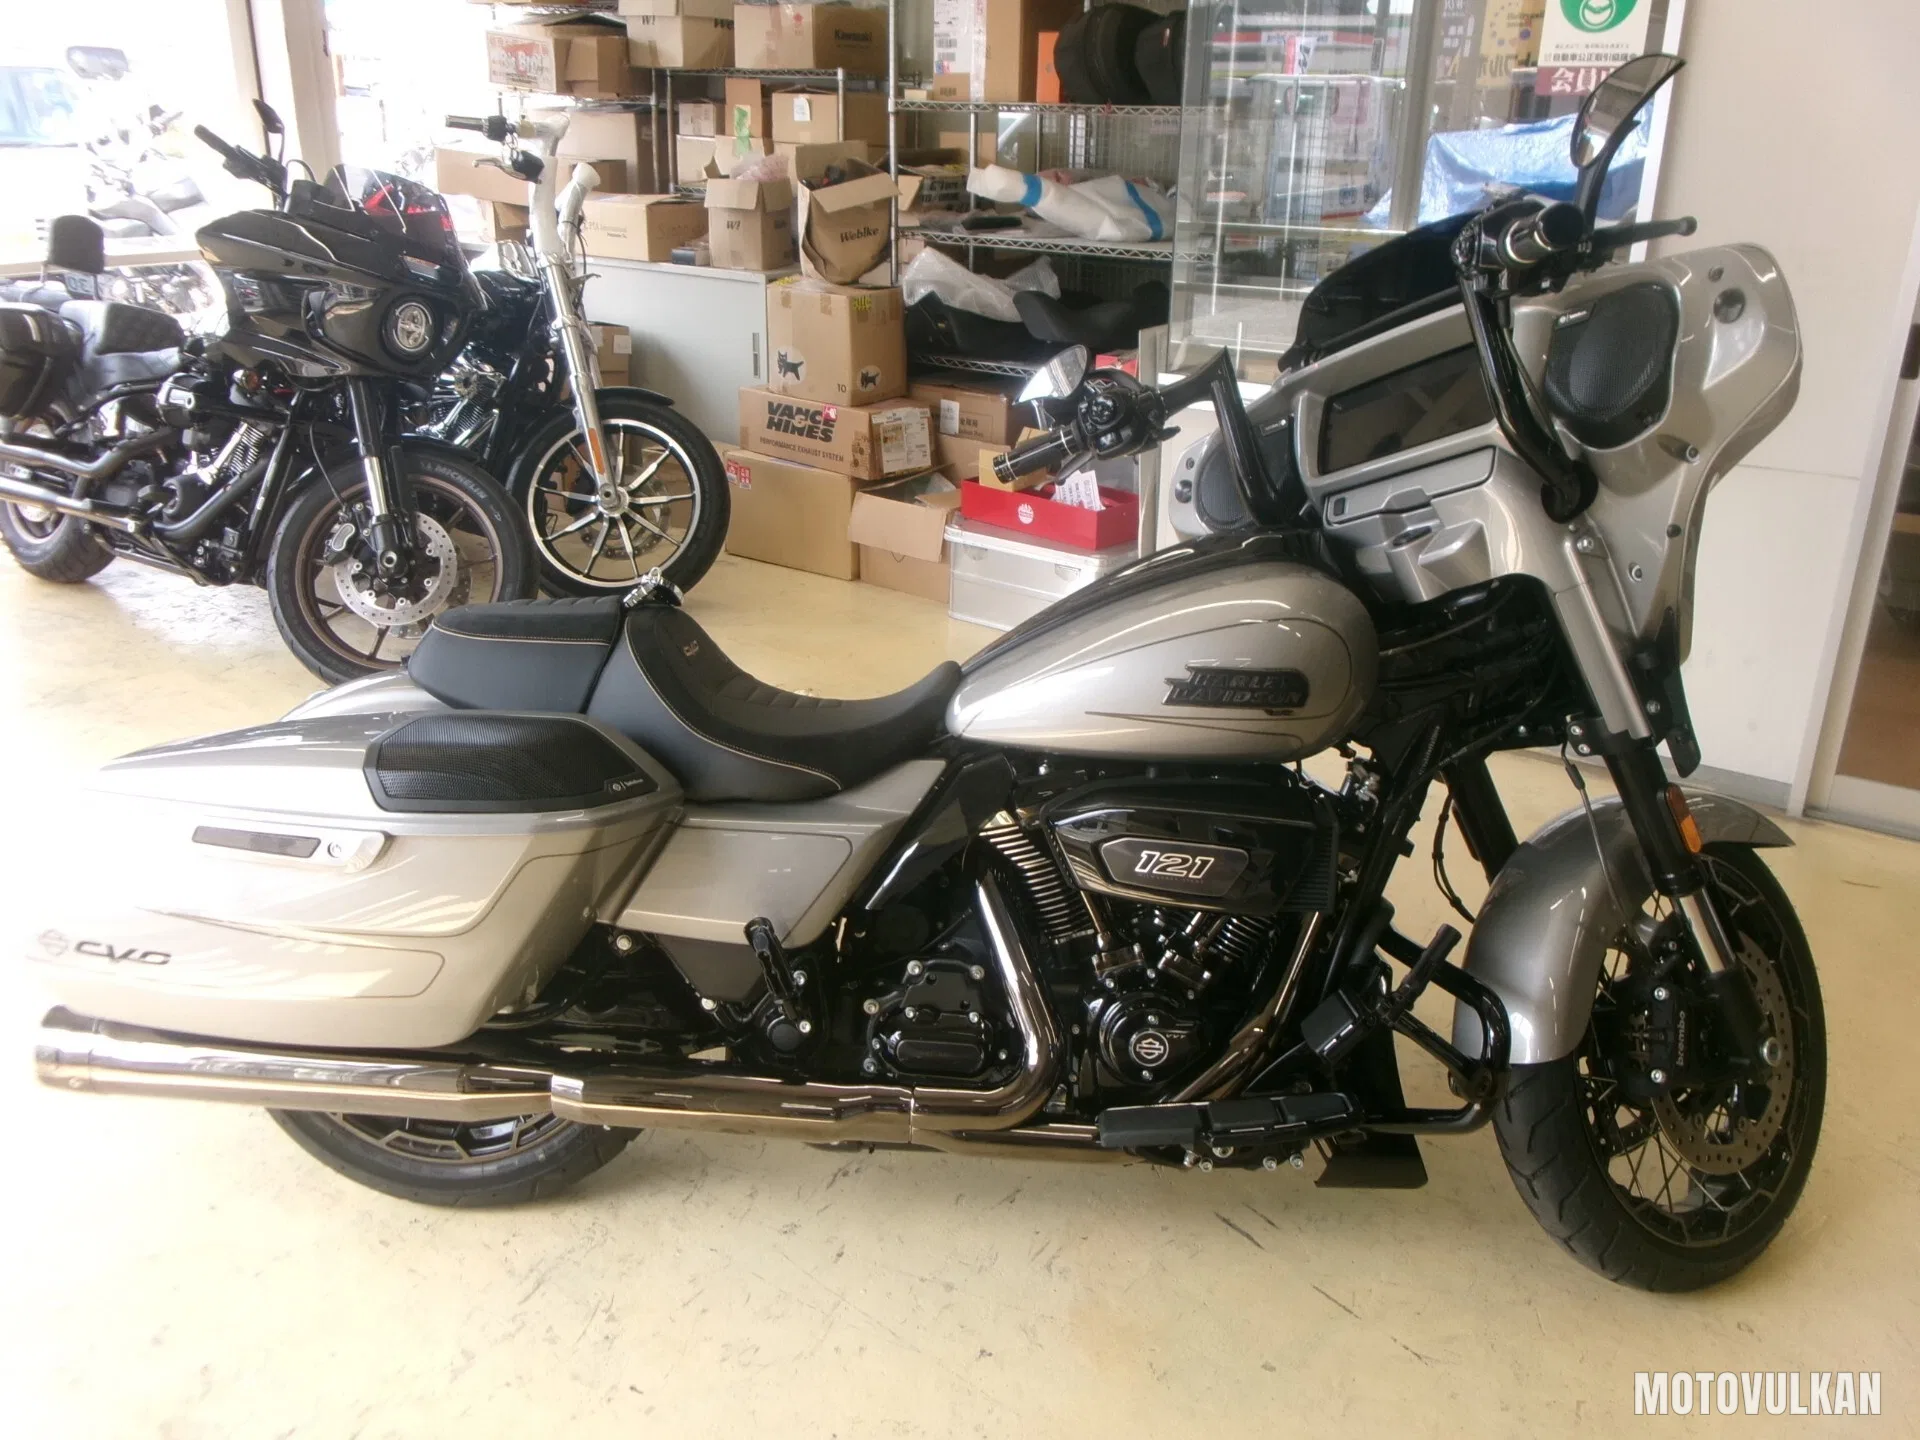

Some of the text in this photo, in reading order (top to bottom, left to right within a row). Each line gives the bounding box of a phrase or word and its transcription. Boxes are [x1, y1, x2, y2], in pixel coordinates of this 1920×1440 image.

[837, 383, 847, 393] 10
[766, 416, 835, 443] HINES
[760, 436, 844, 462] PERFORMANCE EXHAUST SYSTEM
[1134, 849, 1215, 879] 121
